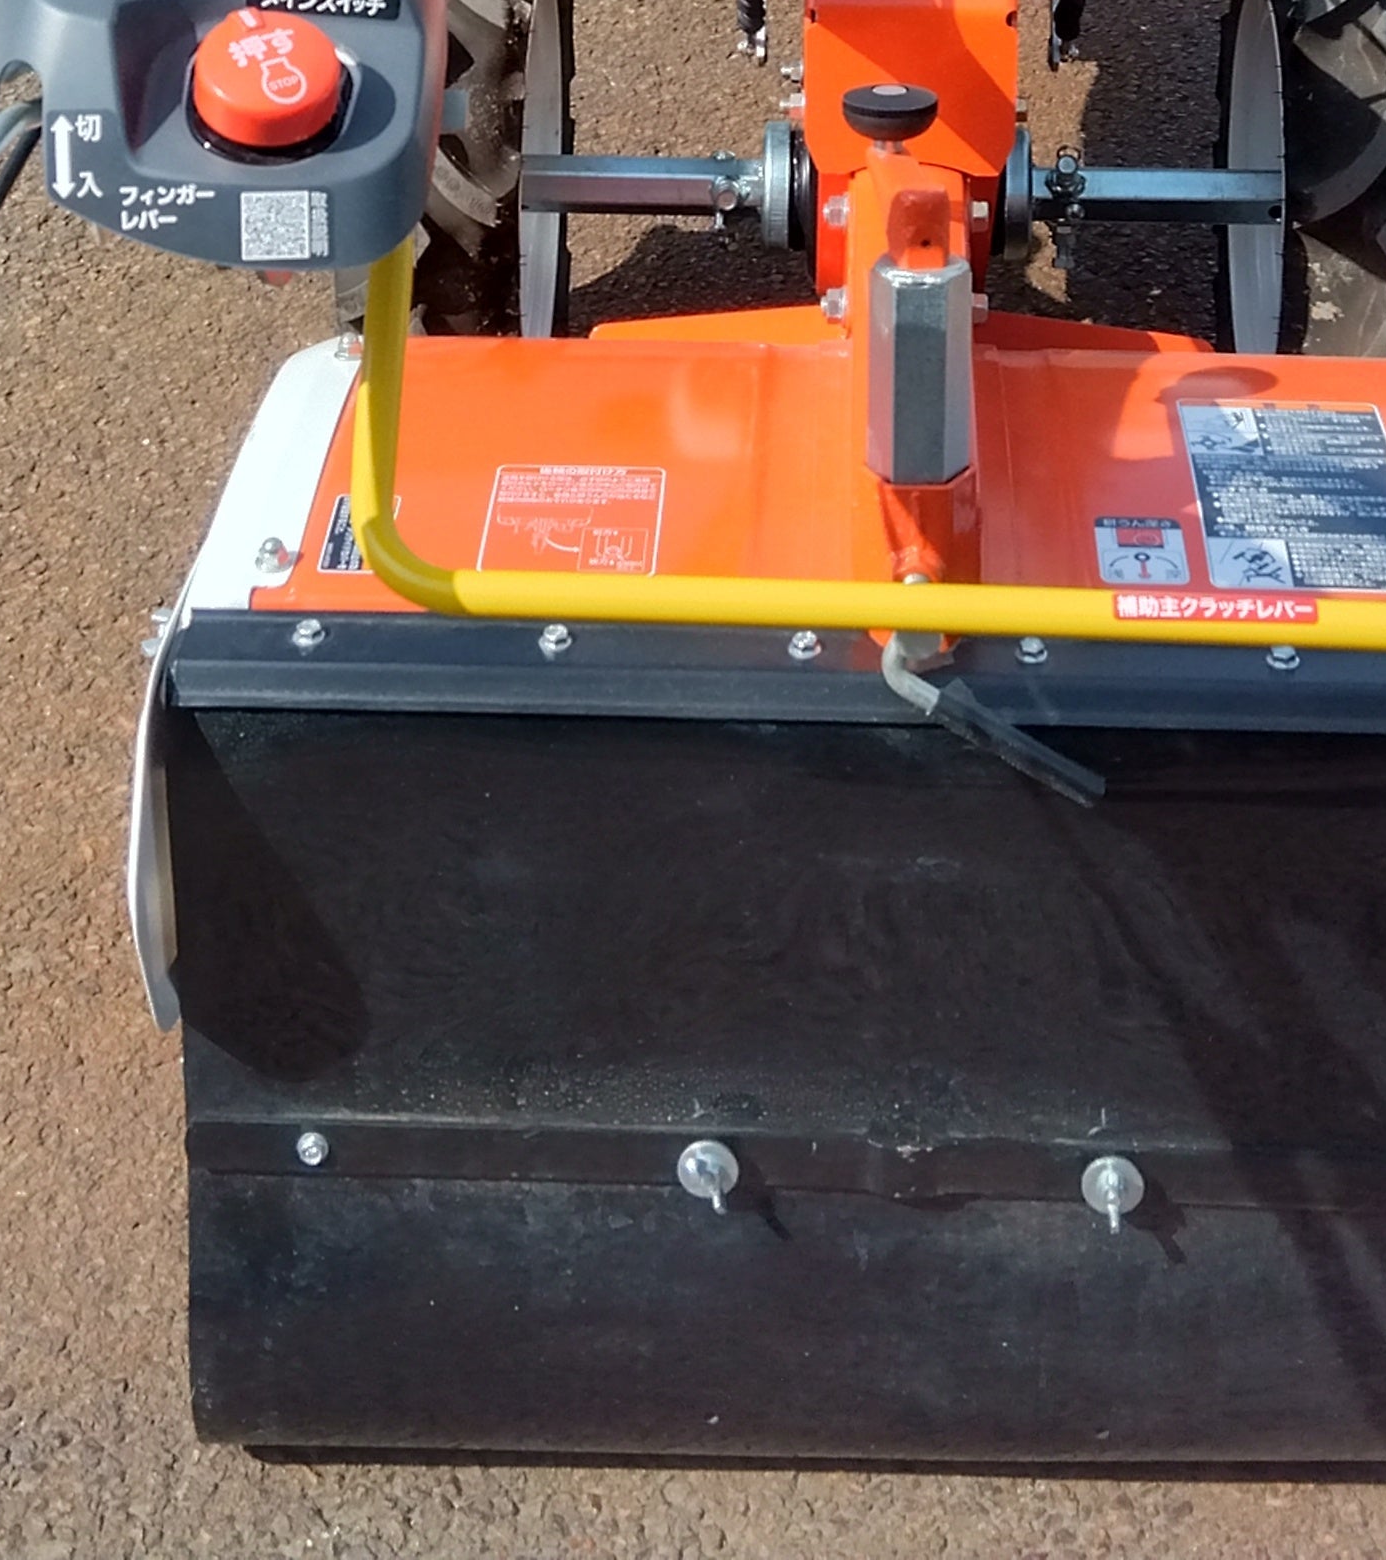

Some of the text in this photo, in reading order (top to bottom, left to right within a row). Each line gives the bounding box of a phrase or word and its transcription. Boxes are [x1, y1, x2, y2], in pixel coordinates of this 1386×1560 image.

[228, 27, 294, 68] 押す
[268, 74, 300, 92] STOP
[74, 114, 102, 141] 切
[76, 171, 104, 198] 入
[118, 183, 216, 207] フィンガー
[120, 209, 178, 231] レバー
[1116, 594, 1314, 620] 補助主クラッチレバー
